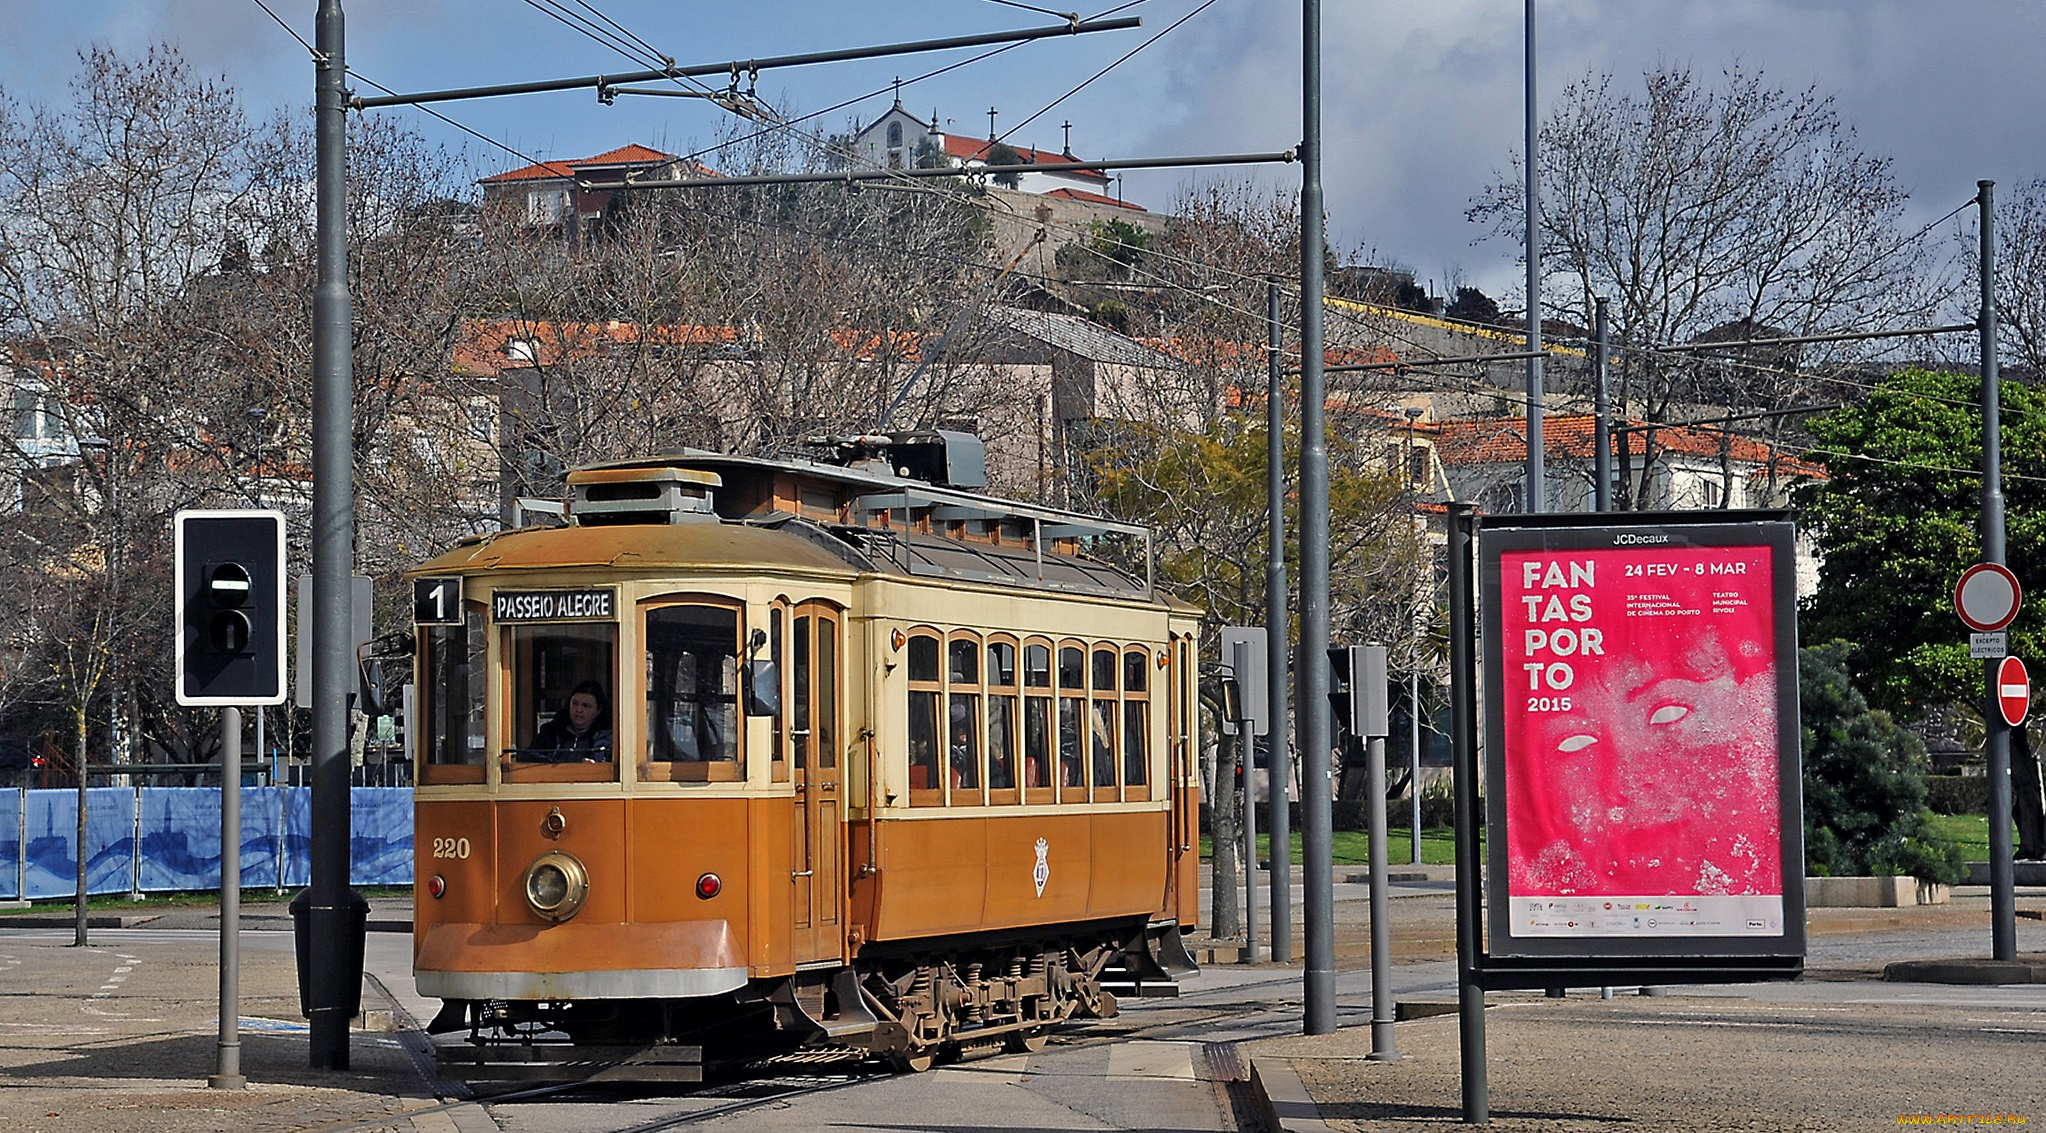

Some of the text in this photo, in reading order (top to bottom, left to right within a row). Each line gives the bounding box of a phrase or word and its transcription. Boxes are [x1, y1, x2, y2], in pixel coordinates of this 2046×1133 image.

[1613, 534, 1669, 545] JCDecaux
[1523, 560, 1595, 589] FAN
[1624, 564, 1643, 577] 24
[1646, 563, 1679, 576] FEV
[1695, 562, 1705, 575] 8
[1710, 562, 1746, 575] MAR
[428, 584, 445, 619] 1
[497, 593, 609, 619] PASSEIO ALEGRE
[1521, 594, 1592, 622] TAS
[1525, 628, 1605, 656] POR
[1523, 662, 1574, 690] TO
[1527, 697, 1572, 712] 2015
[433, 838, 470, 860] 220
